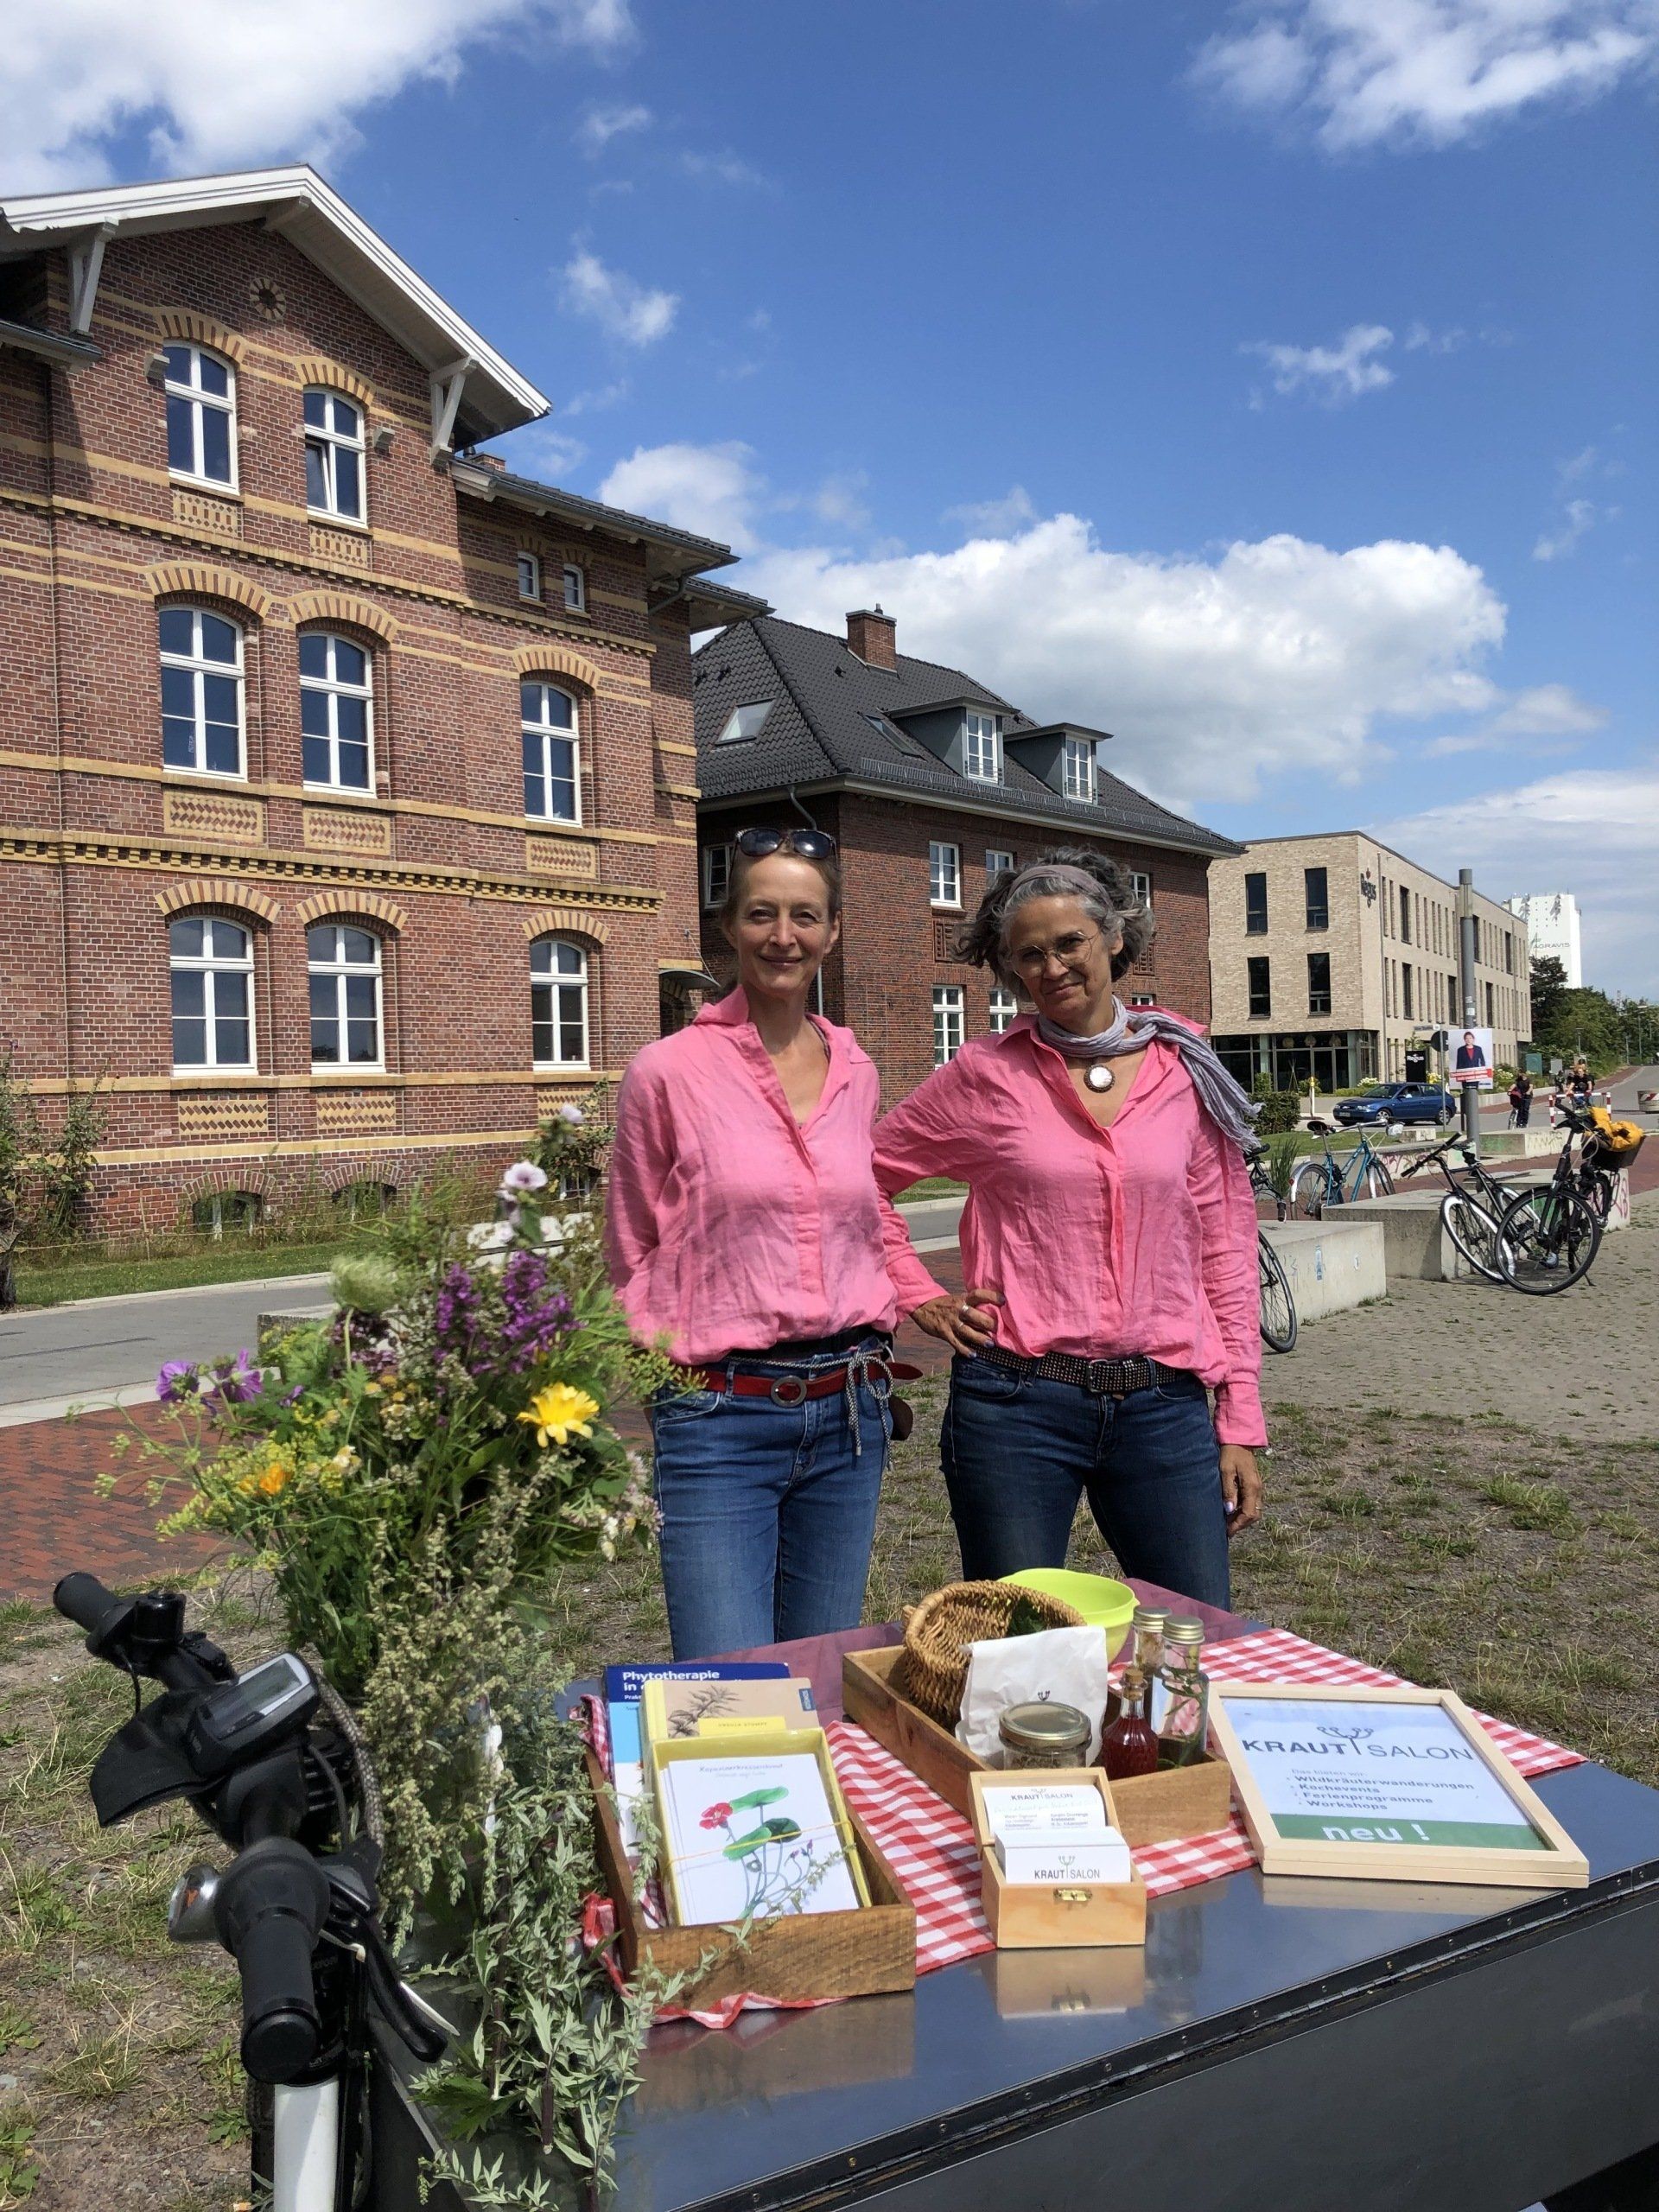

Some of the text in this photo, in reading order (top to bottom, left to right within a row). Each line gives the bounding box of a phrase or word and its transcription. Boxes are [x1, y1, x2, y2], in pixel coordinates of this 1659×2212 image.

[622, 1670, 720, 1681] Phytotherapie
[624, 1682, 637, 1691] in
[1242, 1739, 1474, 1760] KRAUT SALON
[1294, 1776, 1475, 1789] Wildkräuterwanderungen
[1299, 1783, 1381, 1794] Kochevents
[1302, 1792, 1433, 1804] Ferienprogramme
[1306, 1800, 1388, 1811] Workshops
[1321, 1826, 1404, 1841] neu
[1034, 1869, 1100, 1879] KRAUT SALON
